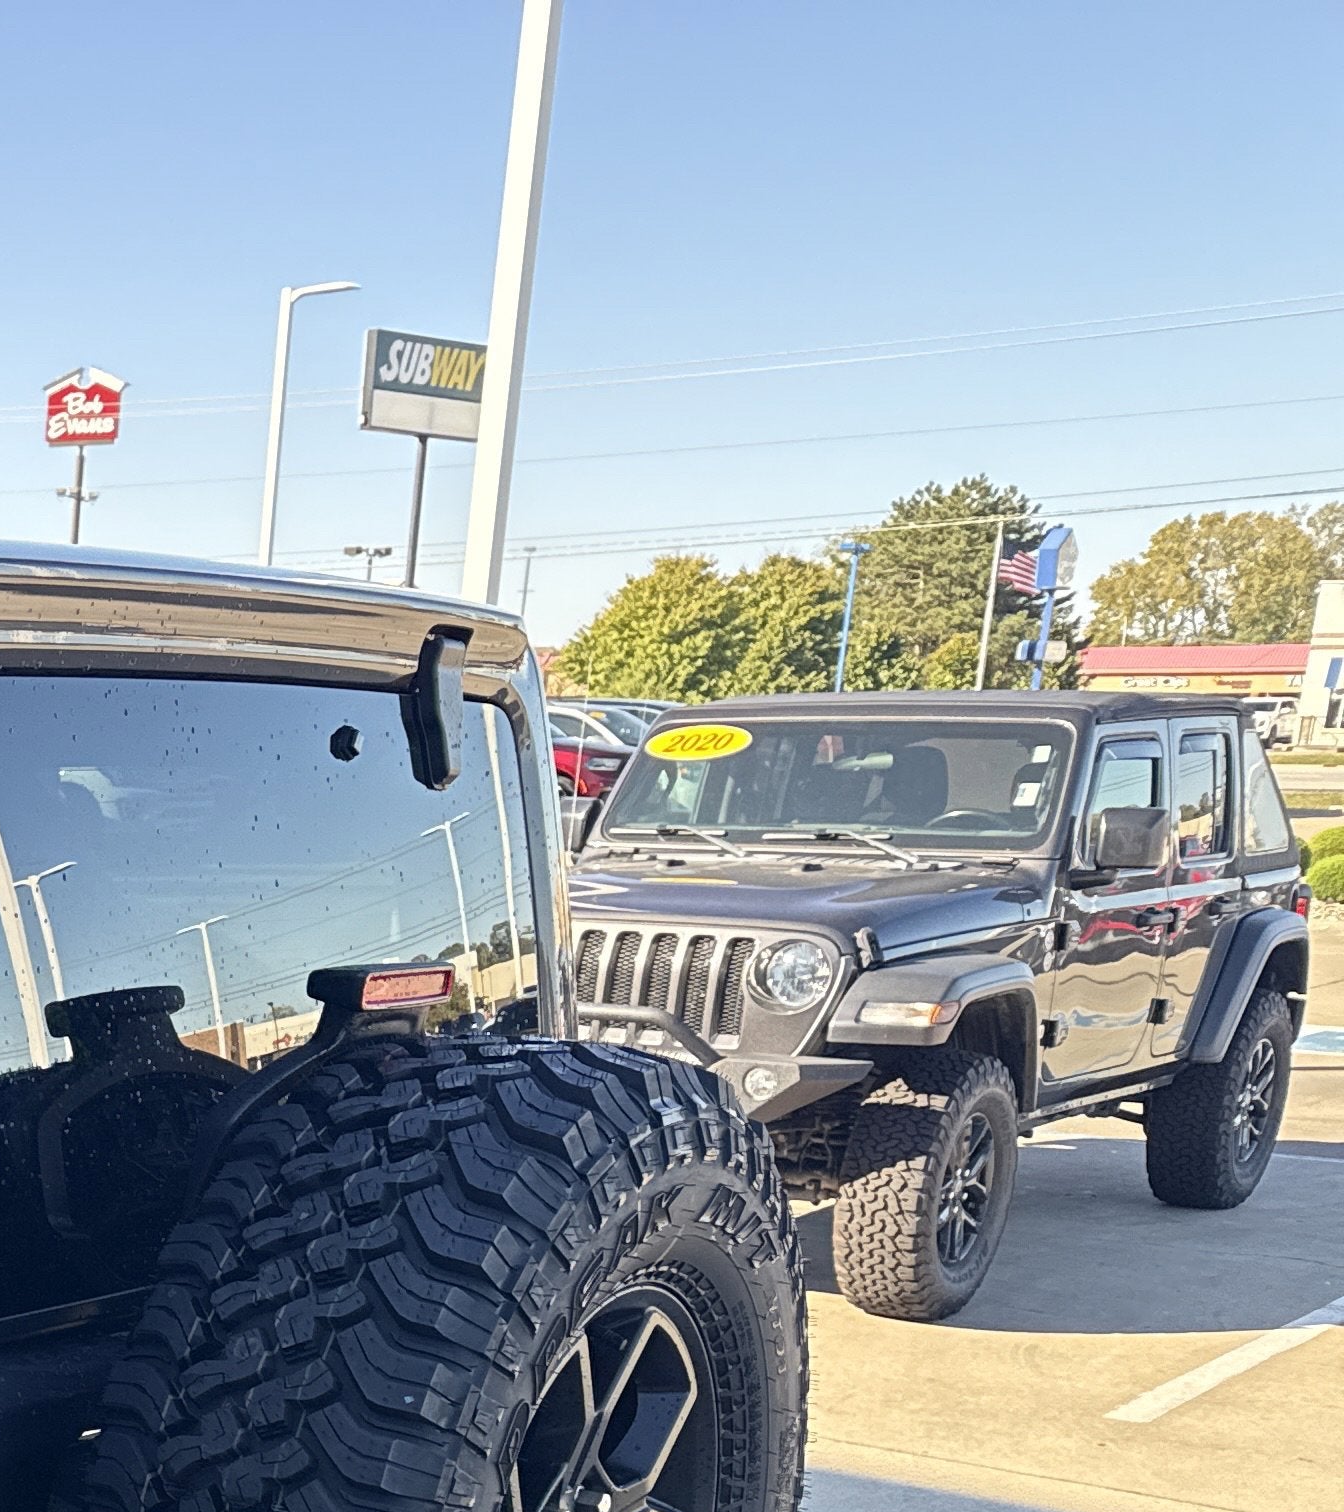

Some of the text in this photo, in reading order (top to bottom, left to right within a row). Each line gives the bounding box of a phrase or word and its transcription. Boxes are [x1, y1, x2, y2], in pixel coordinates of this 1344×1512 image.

[379, 339, 486, 391] SUBWAY
[62, 391, 104, 415] Bob
[48, 412, 115, 439] Evans
[662, 733, 734, 752] 2020
